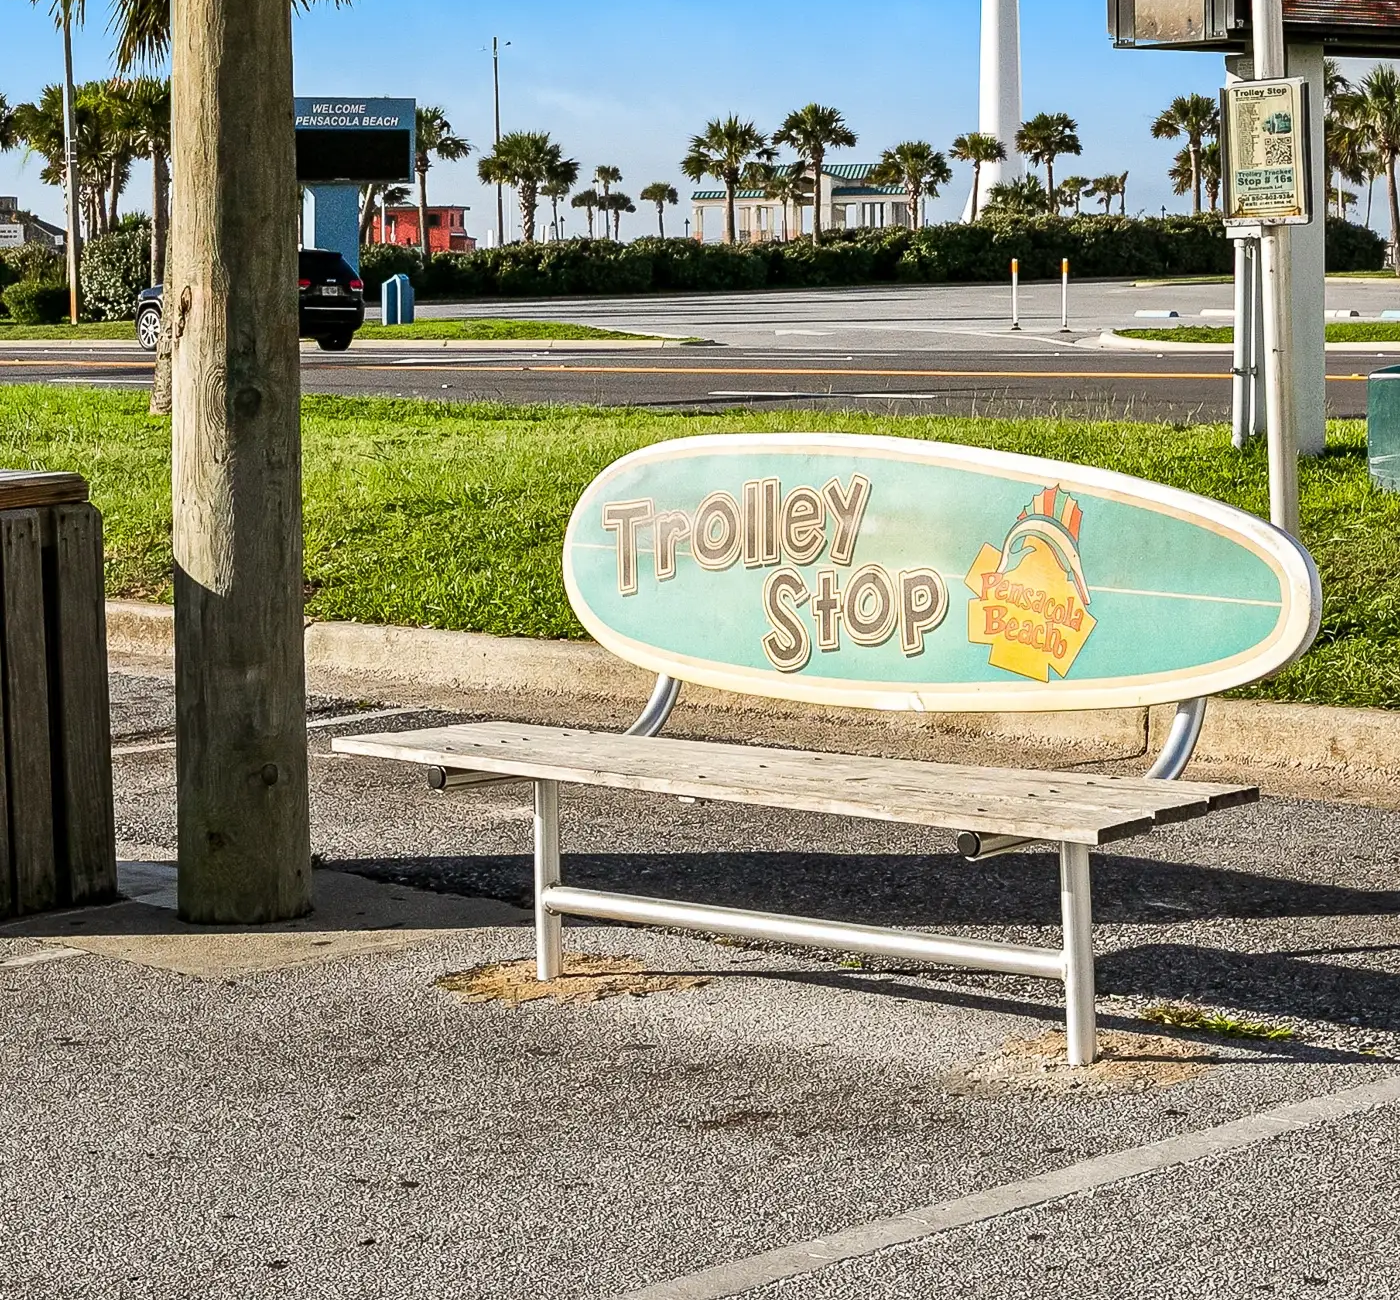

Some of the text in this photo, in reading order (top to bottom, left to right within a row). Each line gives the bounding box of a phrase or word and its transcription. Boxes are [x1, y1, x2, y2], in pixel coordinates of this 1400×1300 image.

[1234, 88, 1287, 97] Trolley Stop
[312, 104, 366, 114] WELCOME
[295, 116, 399, 127] PENSACOLA BEACH
[1237, 177, 1262, 186] Stop
[1274, 174, 1293, 184] 16s
[602, 472, 872, 596] Trolley
[979, 571, 1084, 632] Pensacola
[761, 563, 950, 674] Stop
